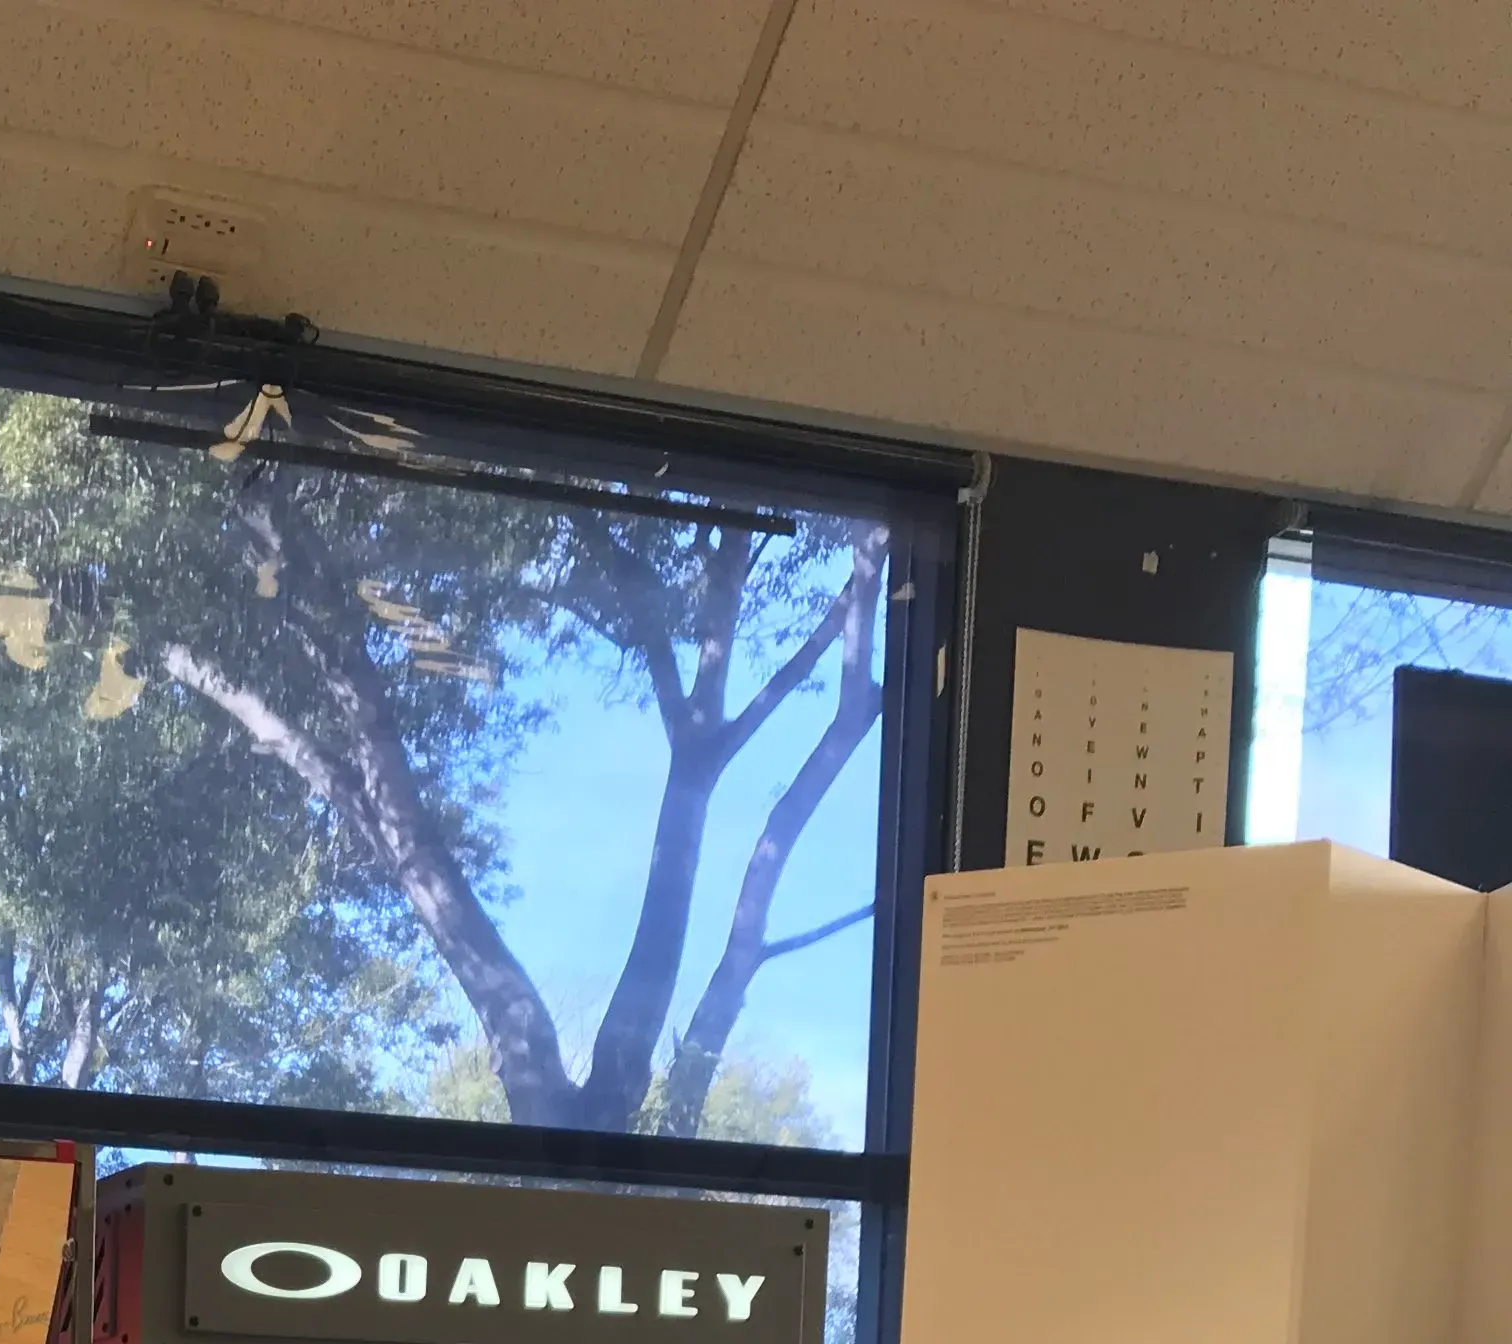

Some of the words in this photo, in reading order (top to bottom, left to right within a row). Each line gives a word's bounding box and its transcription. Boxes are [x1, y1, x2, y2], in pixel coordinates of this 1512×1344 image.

[1033, 710, 1042, 721] A
[1088, 717, 1096, 728] V
[1140, 722, 1147, 734] E
[1198, 727, 1207, 739] A
[1032, 733, 1042, 747] N
[1086, 740, 1095, 754] E
[1136, 745, 1149, 760] W
[1196, 751, 1206, 764] P
[1031, 761, 1043, 777] O
[1134, 773, 1147, 790] N
[1193, 777, 1204, 794] T
[1029, 796, 1046, 817] O
[1081, 802, 1095, 823] F
[1131, 807, 1147, 829] V
[1196, 812, 1202, 833] I
[1026, 839, 1045, 866] E
[1071, 844, 1101, 862] W
[377, 1252, 767, 1322] OAKLEY
